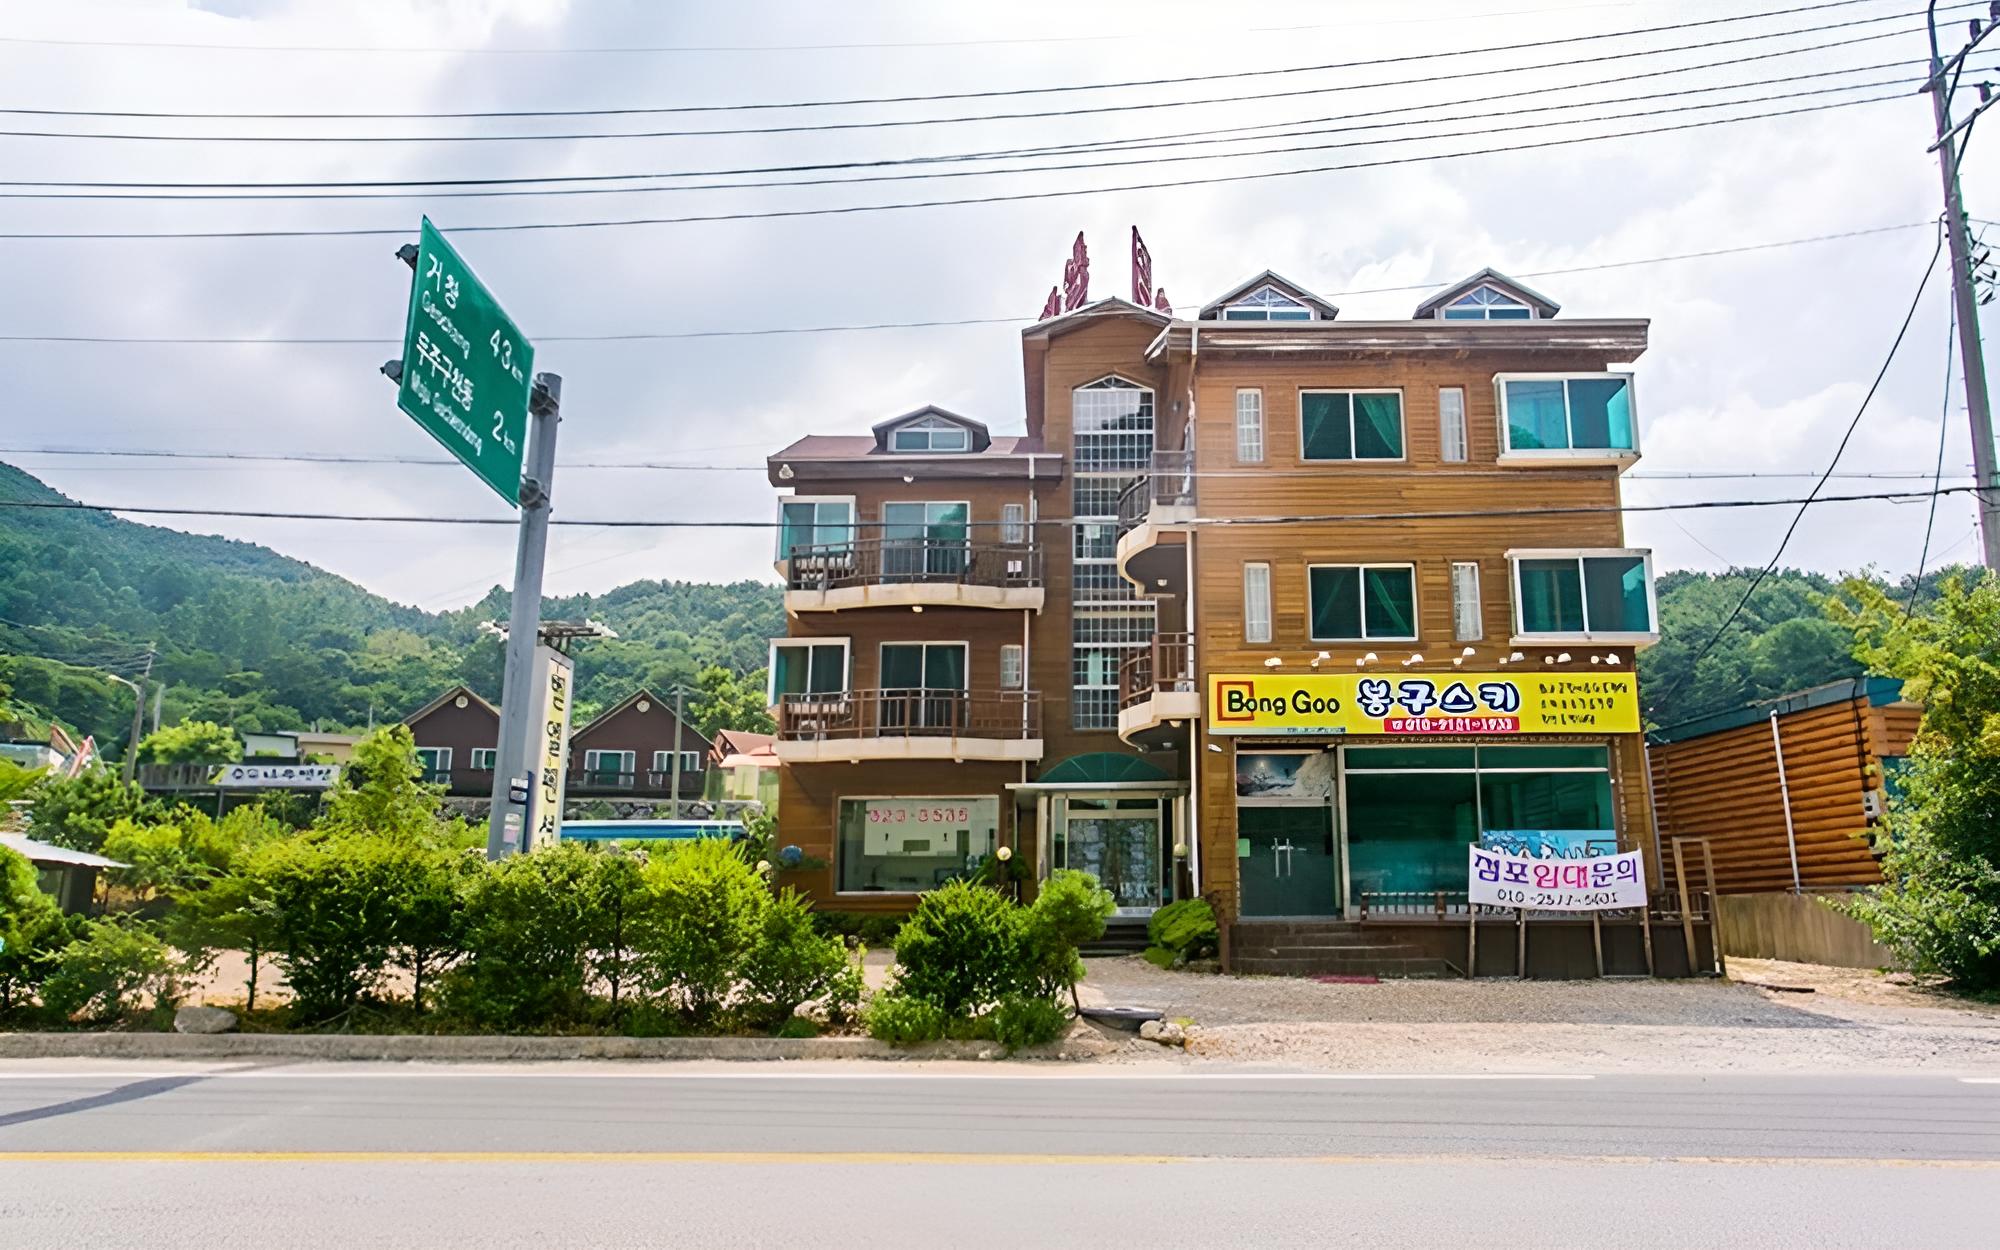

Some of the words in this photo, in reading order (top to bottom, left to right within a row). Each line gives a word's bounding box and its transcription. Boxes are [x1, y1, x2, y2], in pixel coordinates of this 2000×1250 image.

[1228, 690, 1286, 716] Bong
[1292, 690, 1340, 714] Goo
[1356, 679, 1520, 717] 봉구스키
